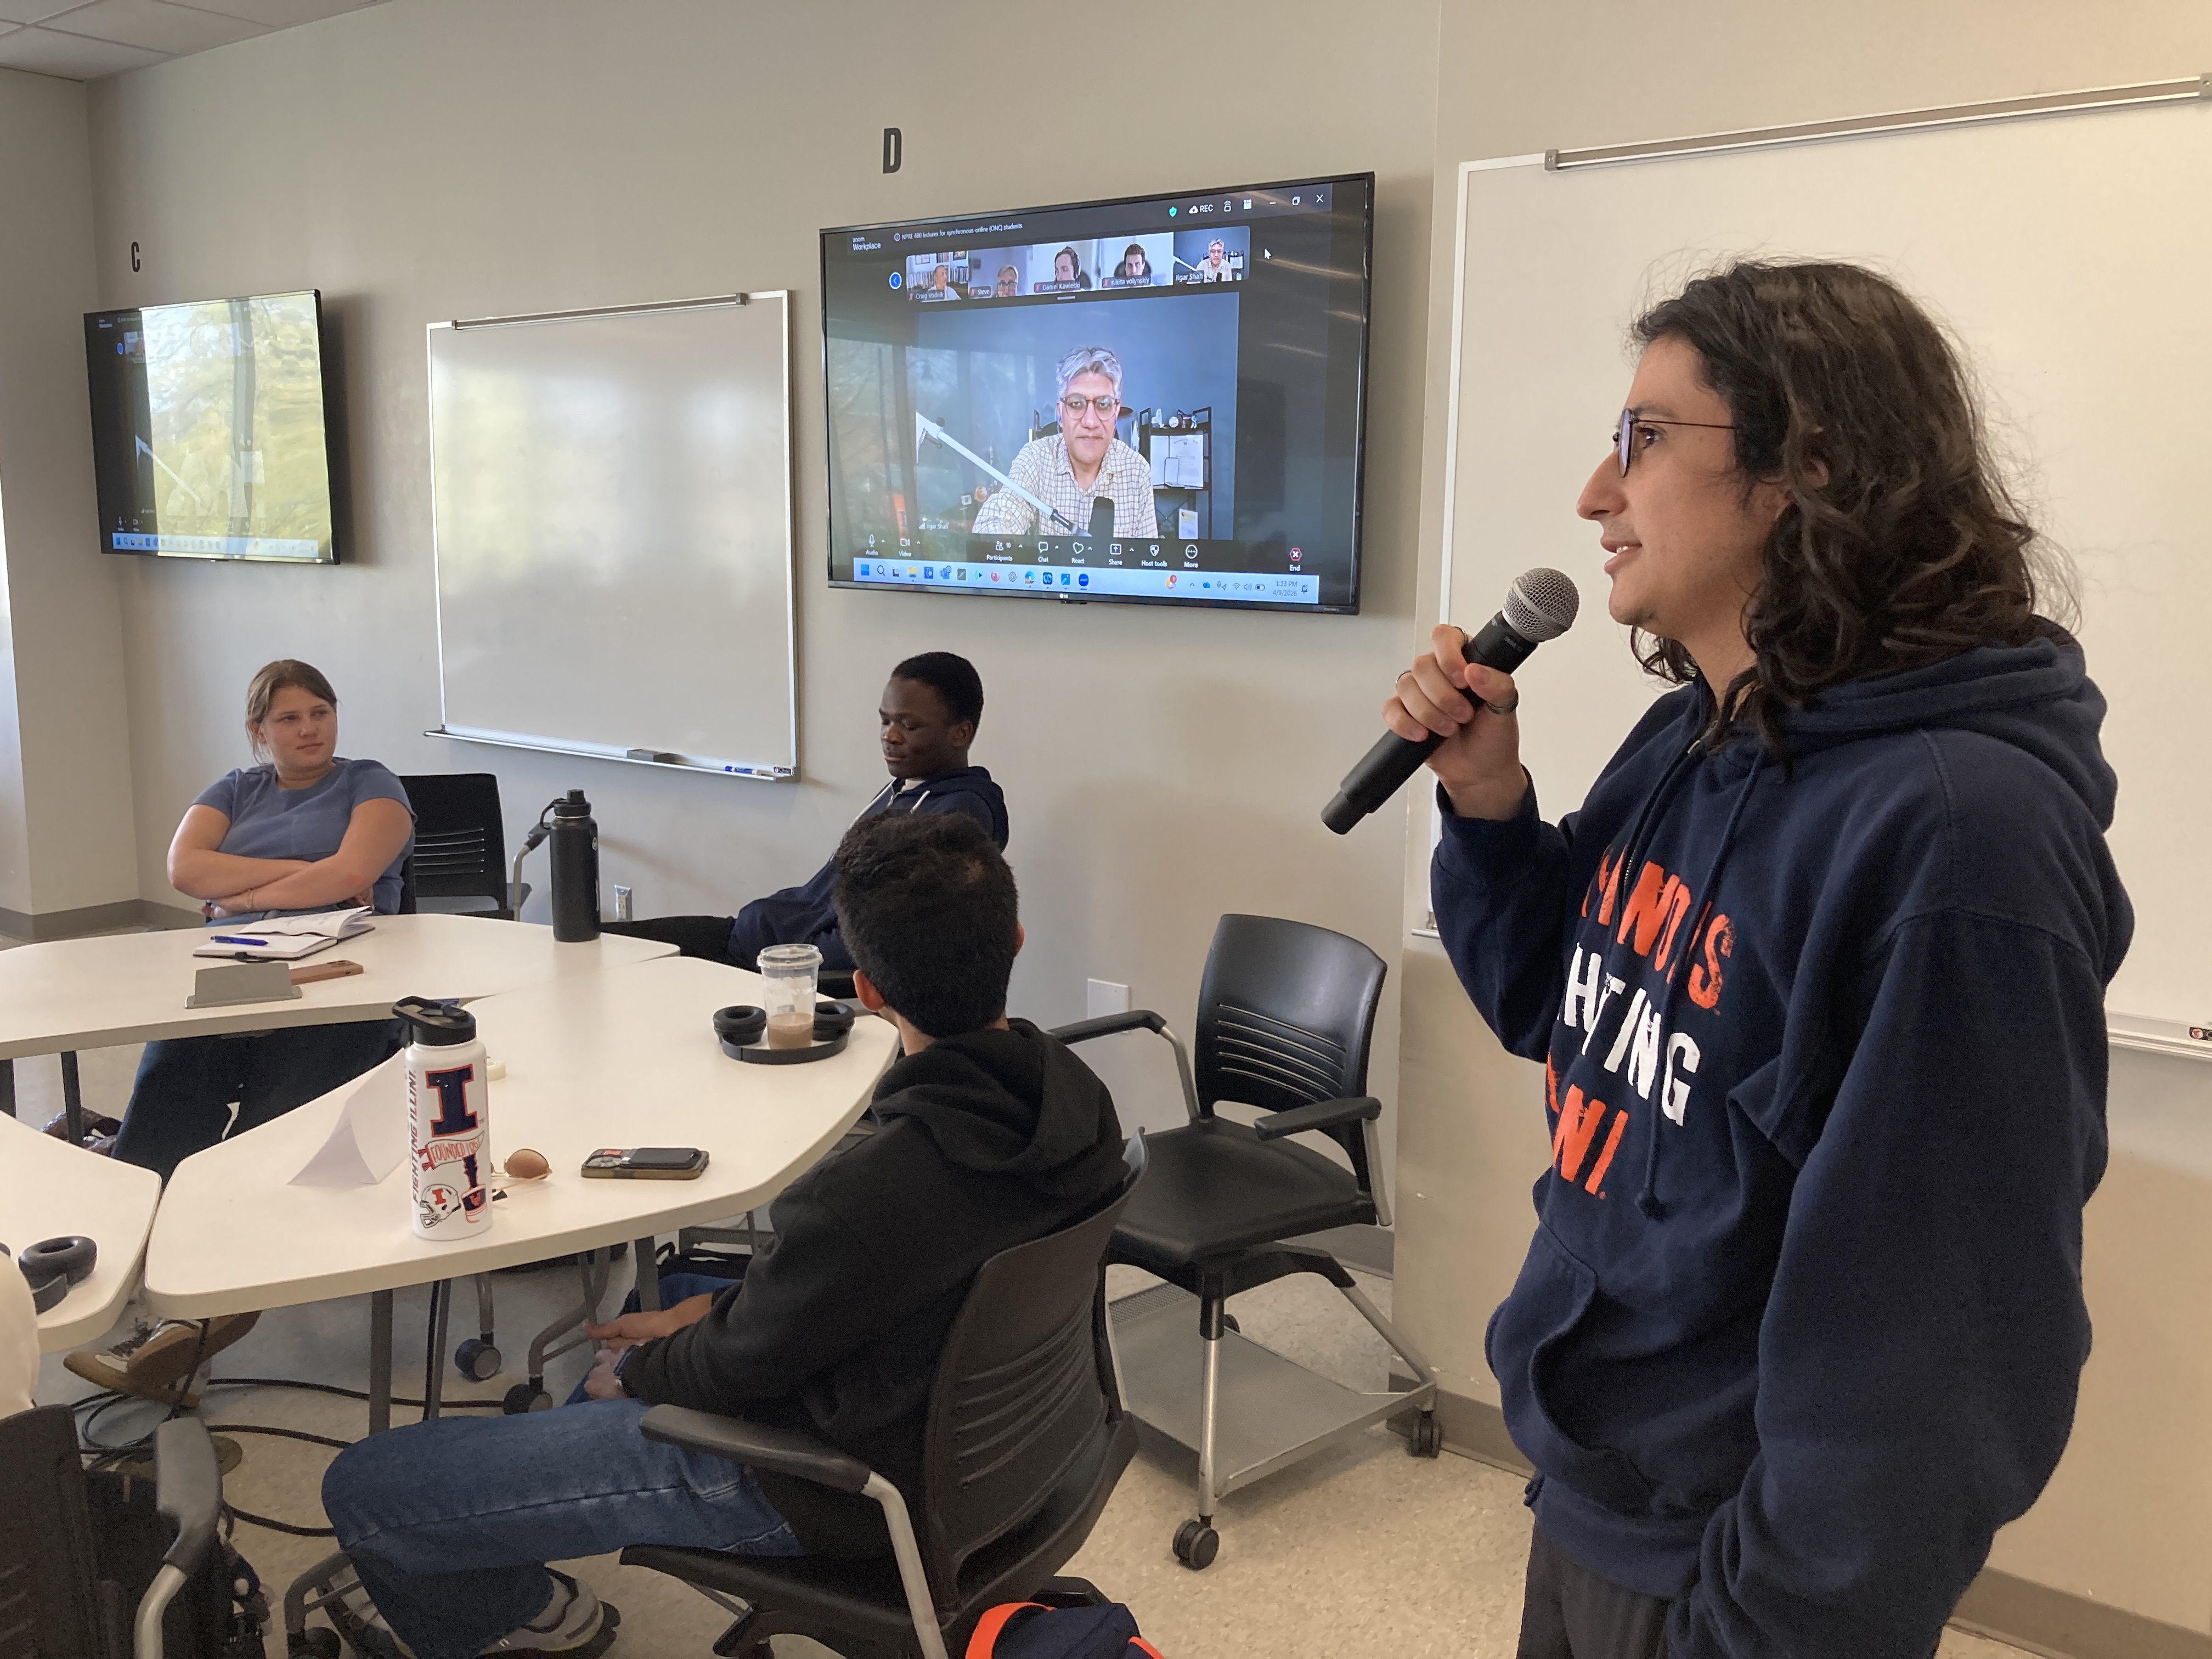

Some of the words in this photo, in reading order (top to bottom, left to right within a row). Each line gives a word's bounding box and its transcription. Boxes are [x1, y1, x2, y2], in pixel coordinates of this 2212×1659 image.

[883, 127, 901, 174] D
[1200, 204, 1214, 213] REC
[947, 226, 988, 237] synchronous-online
[989, 224, 1003, 233] (ONC)
[853, 242, 881, 251] Workplace
[131, 242, 140, 272] C
[1059, 281, 1081, 289] Kawiecki
[1126, 277, 1150, 285] volynskiy
[1176, 274, 1189, 283] Jigar
[409, 1070, 417, 1122] ILLINI
[425, 1064, 478, 1138] I
[430, 1142, 465, 1163] FOUNDED
[410, 1123, 419, 1204] FIGHTING
[432, 1188, 446, 1205] I
